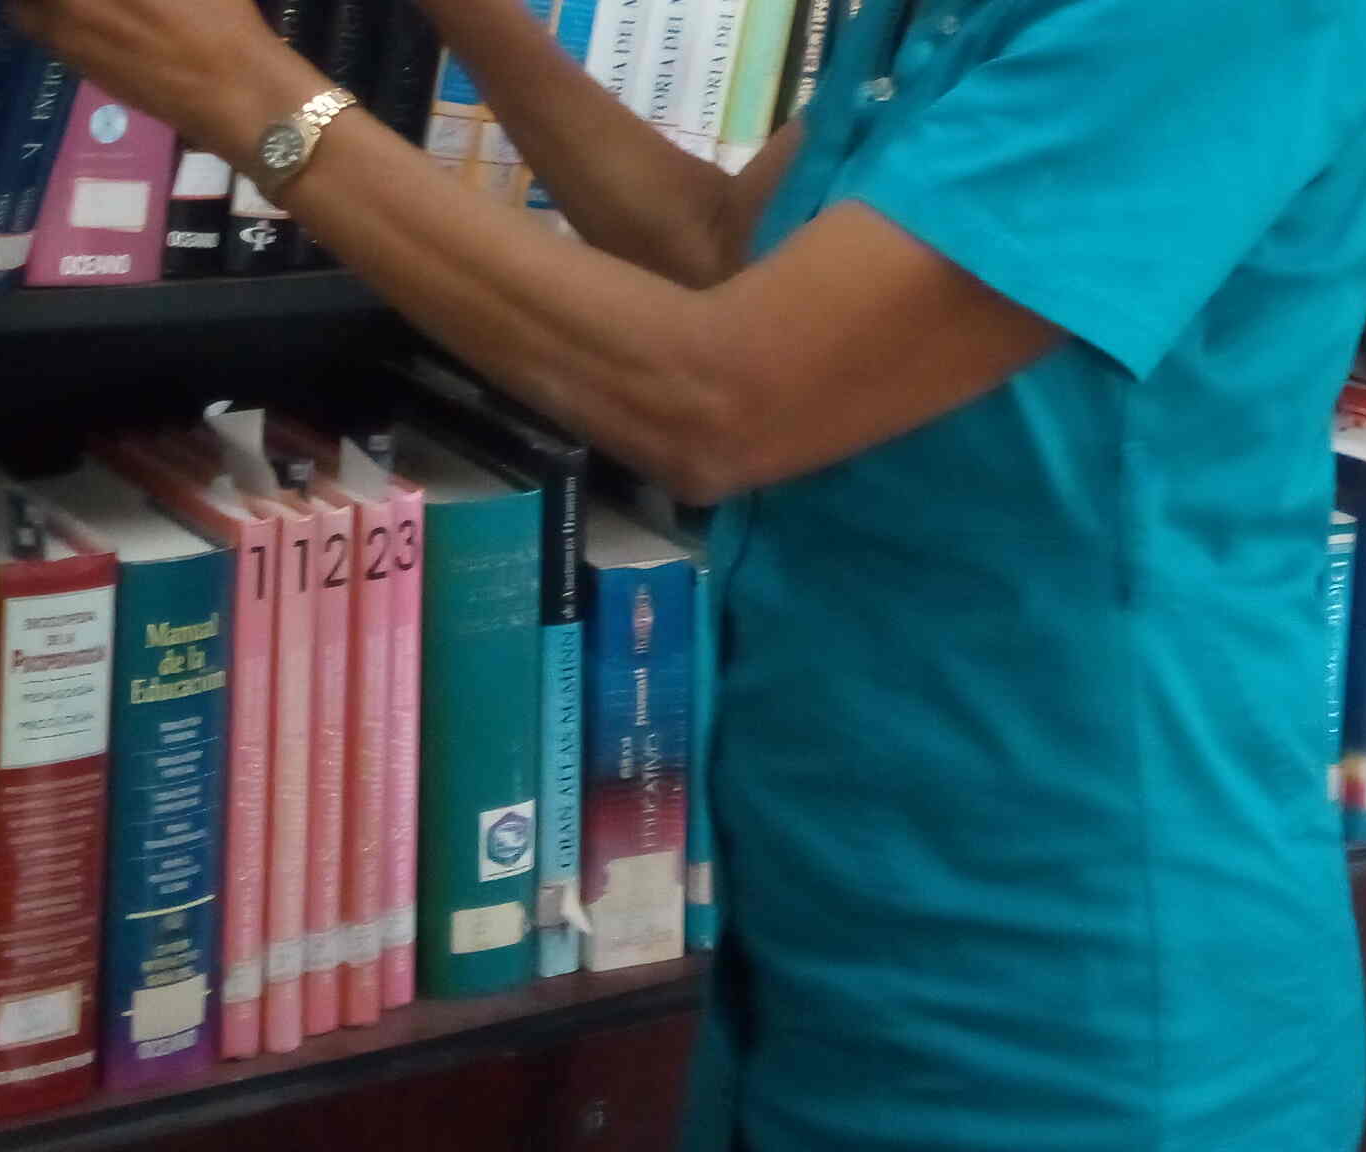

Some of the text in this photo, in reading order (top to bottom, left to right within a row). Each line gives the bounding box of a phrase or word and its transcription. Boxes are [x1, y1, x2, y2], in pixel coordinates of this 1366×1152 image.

[21, 142, 43, 159] 7
[293, 539, 310, 592] 1
[323, 533, 349, 589] 2
[366, 527, 391, 581] 2
[395, 519, 415, 572] 3
[251, 546, 266, 601] 1
[146, 612, 219, 648] Manual
[158, 649, 184, 675] de
[559, 729, 581, 799] ATLAS
[558, 806, 577, 868] GRAN
